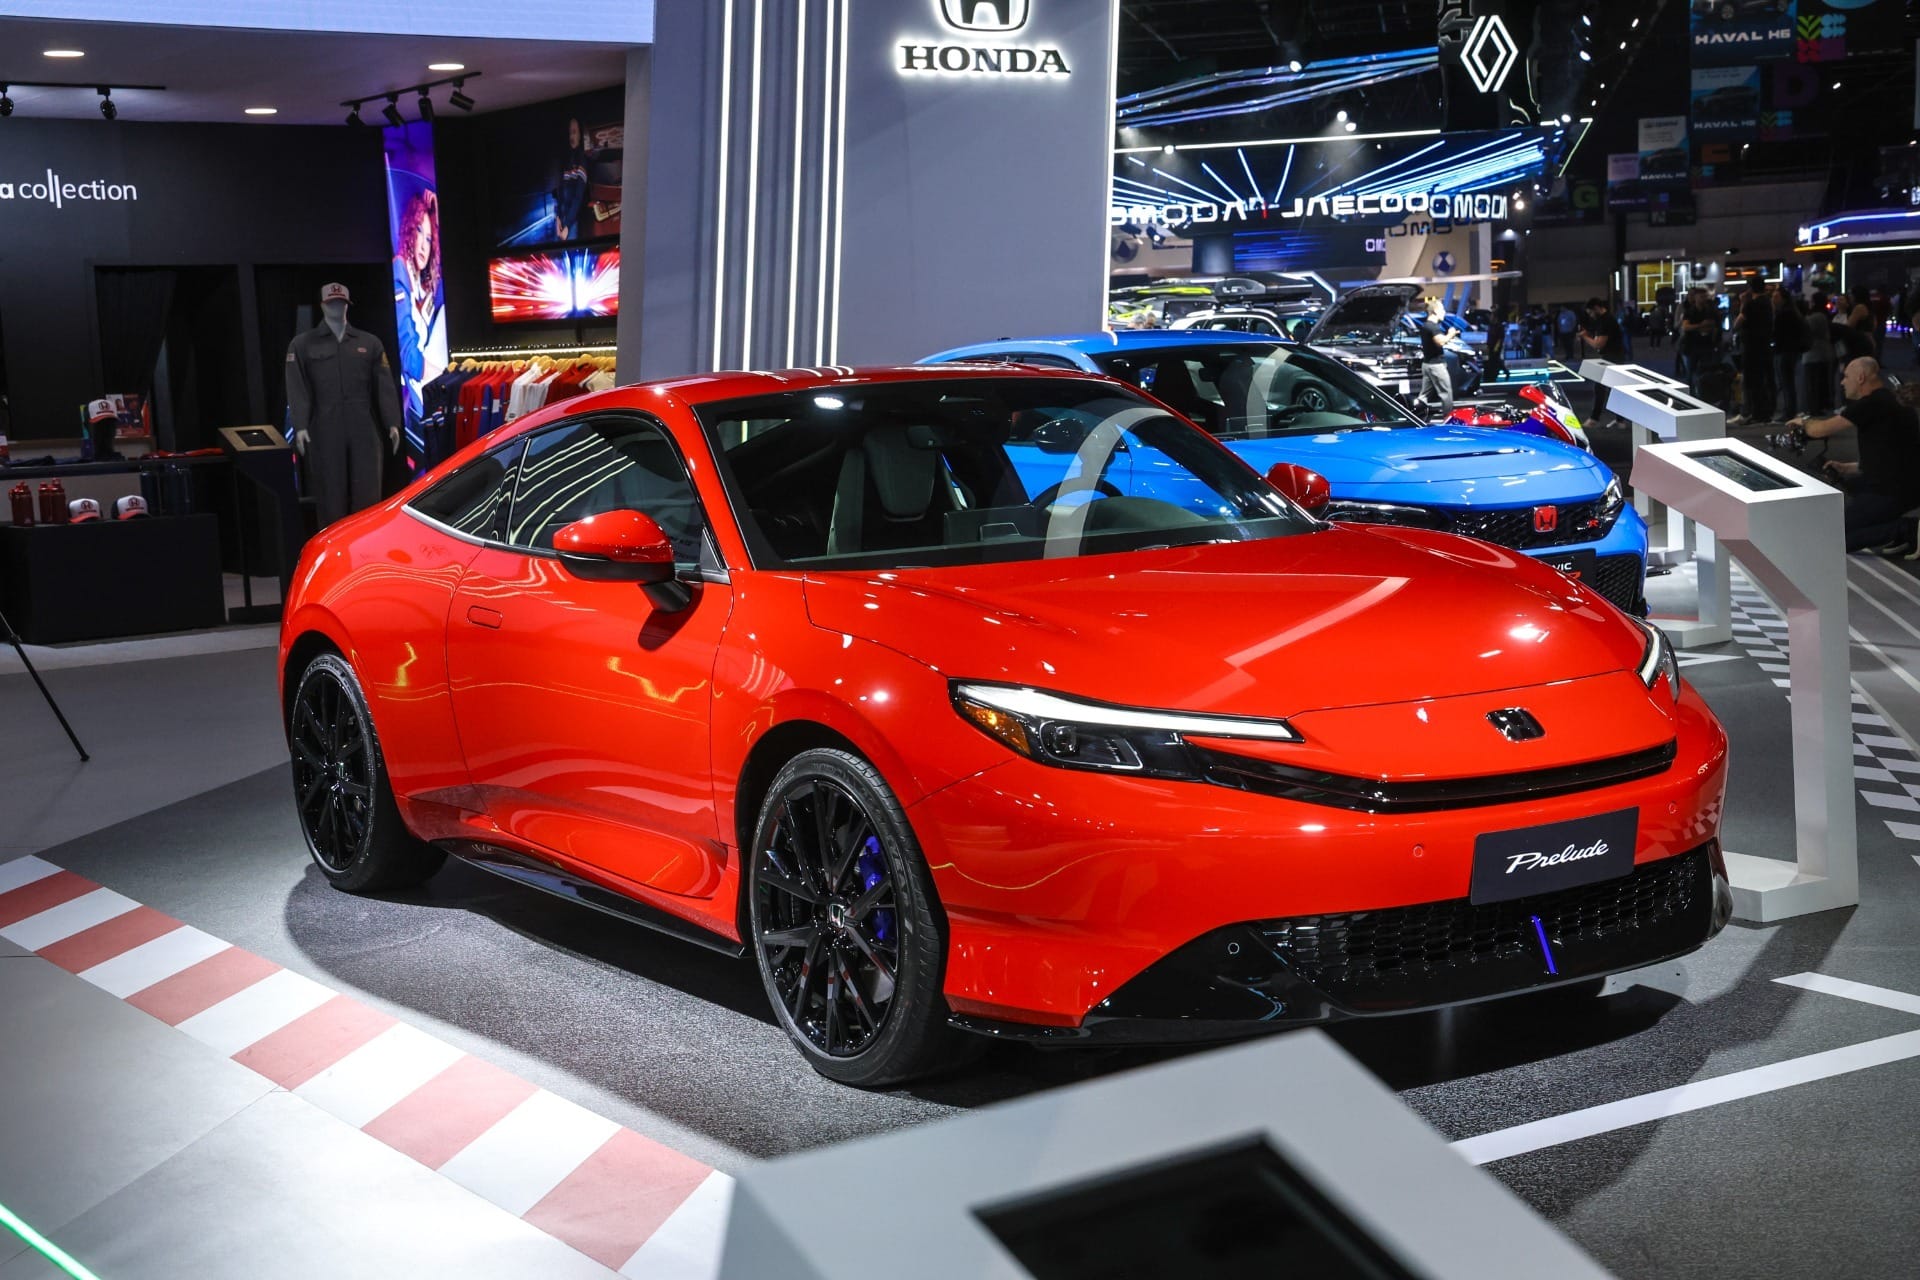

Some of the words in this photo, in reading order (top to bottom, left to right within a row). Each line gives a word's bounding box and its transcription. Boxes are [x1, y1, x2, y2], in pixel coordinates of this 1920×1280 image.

[1695, 30, 1764, 46] HAVAL
[1768, 29, 1791, 41] H6
[900, 45, 1071, 74] HONDA
[1693, 120, 1738, 130] HAVAL
[18, 168, 138, 209] collection
[1281, 192, 1431, 218] JAECOO
[1504, 838, 1609, 875] Prelude
